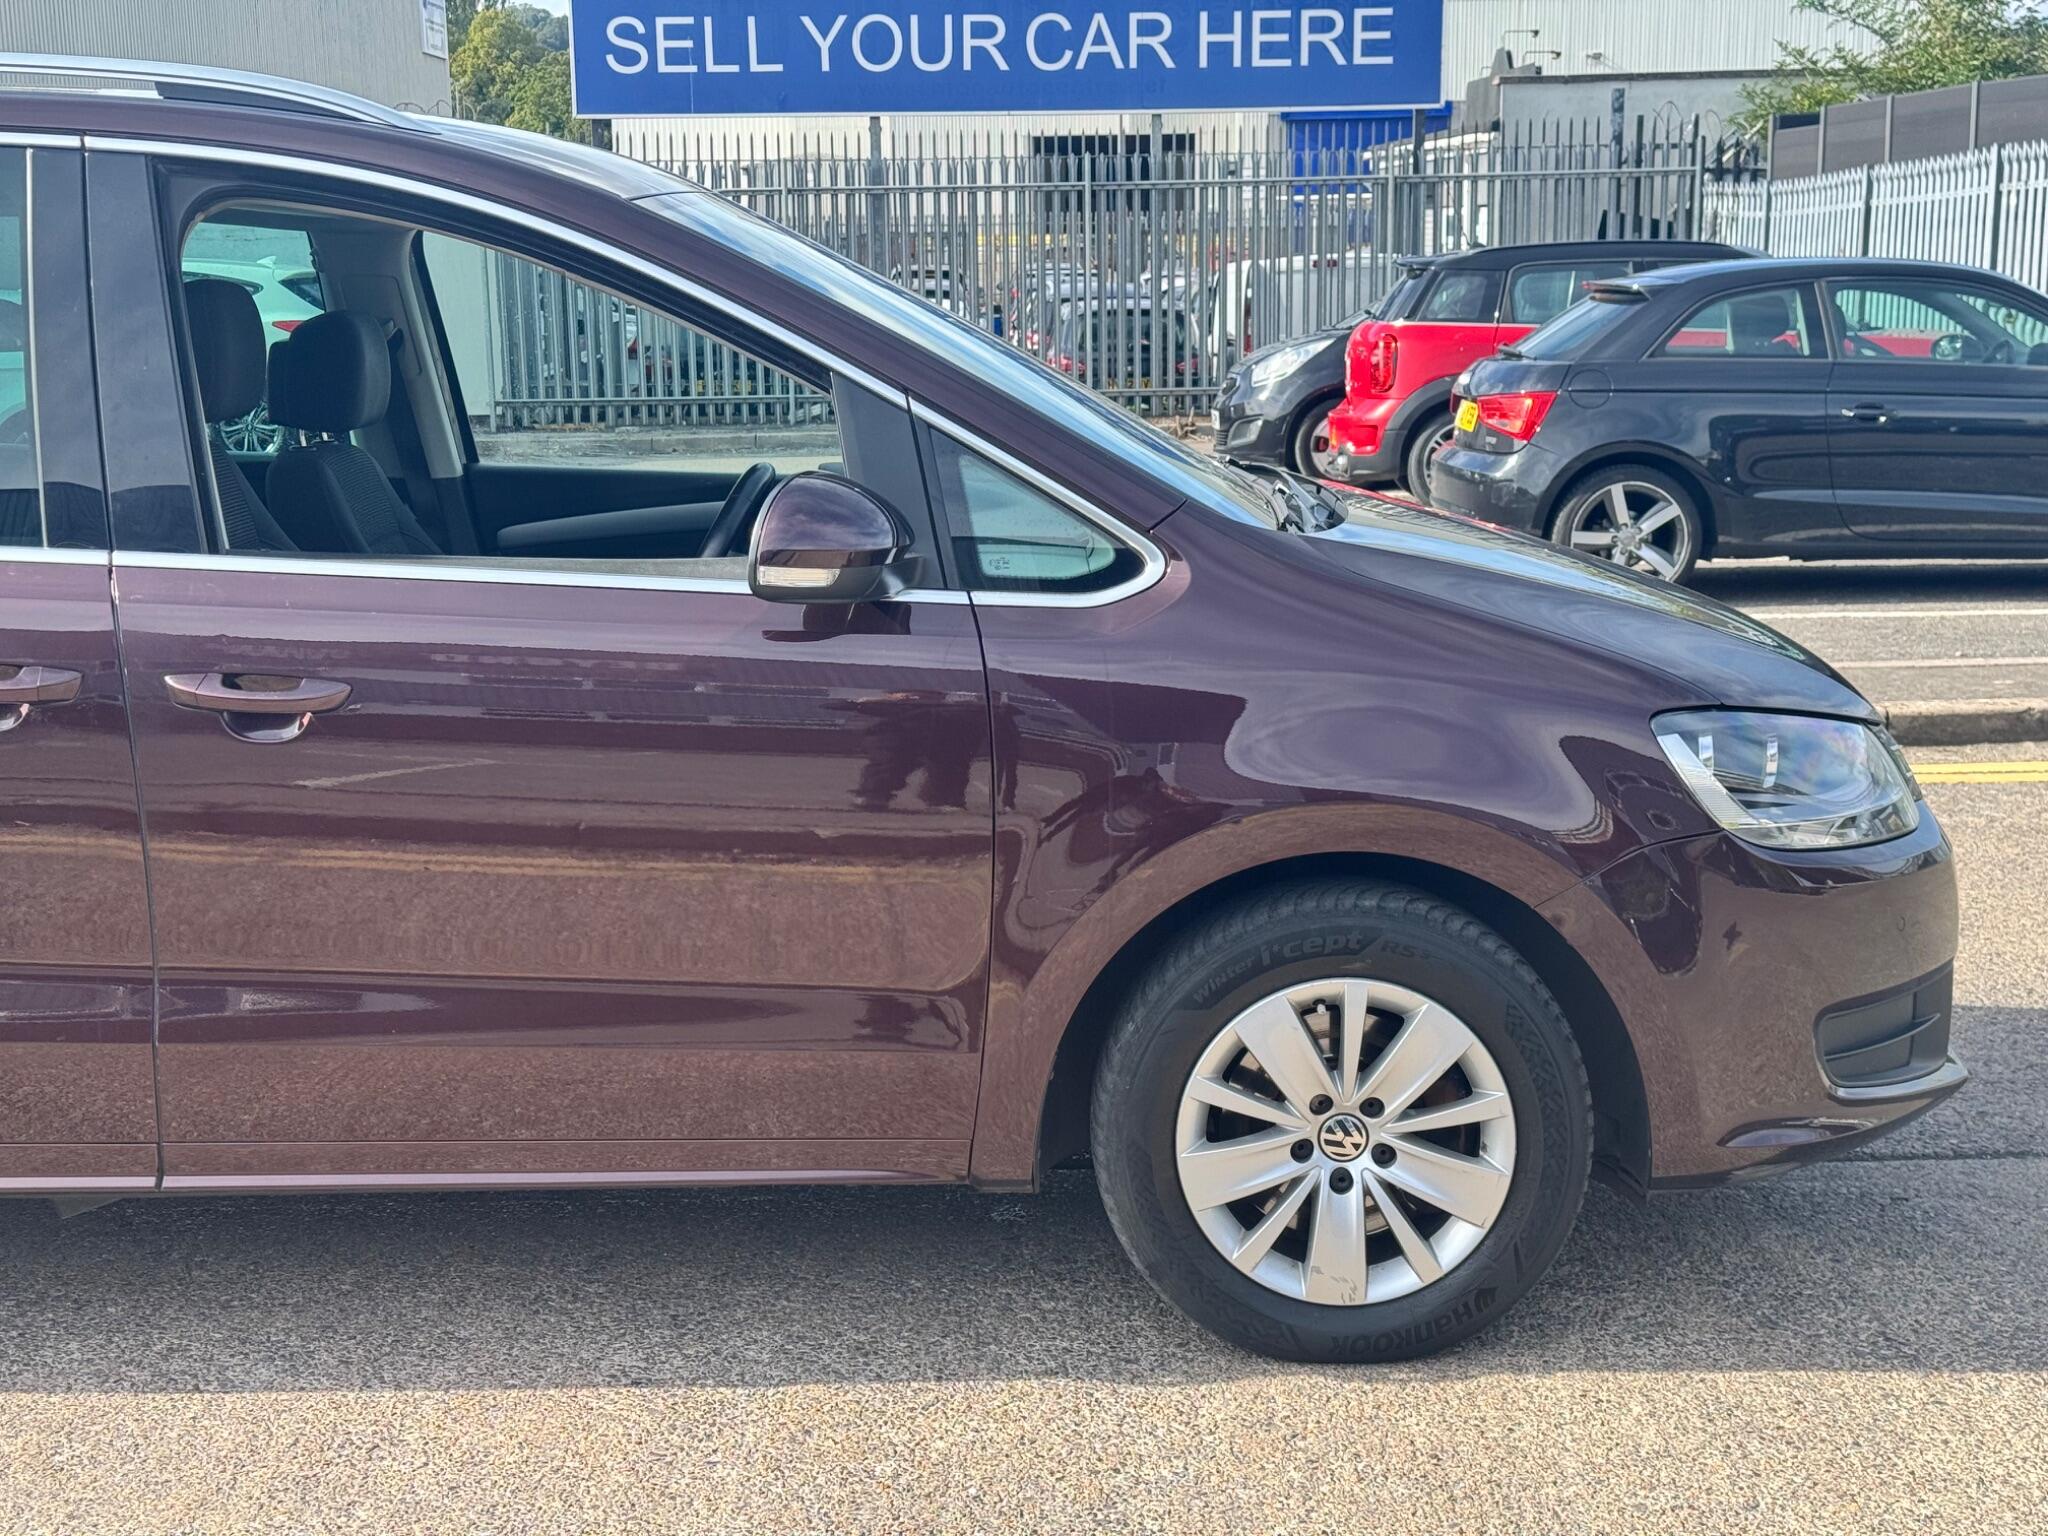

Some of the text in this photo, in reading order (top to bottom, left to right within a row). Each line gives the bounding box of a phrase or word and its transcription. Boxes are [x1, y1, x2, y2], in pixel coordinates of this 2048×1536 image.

[605, 7, 1394, 74] SELL YOUR CAR HERE
